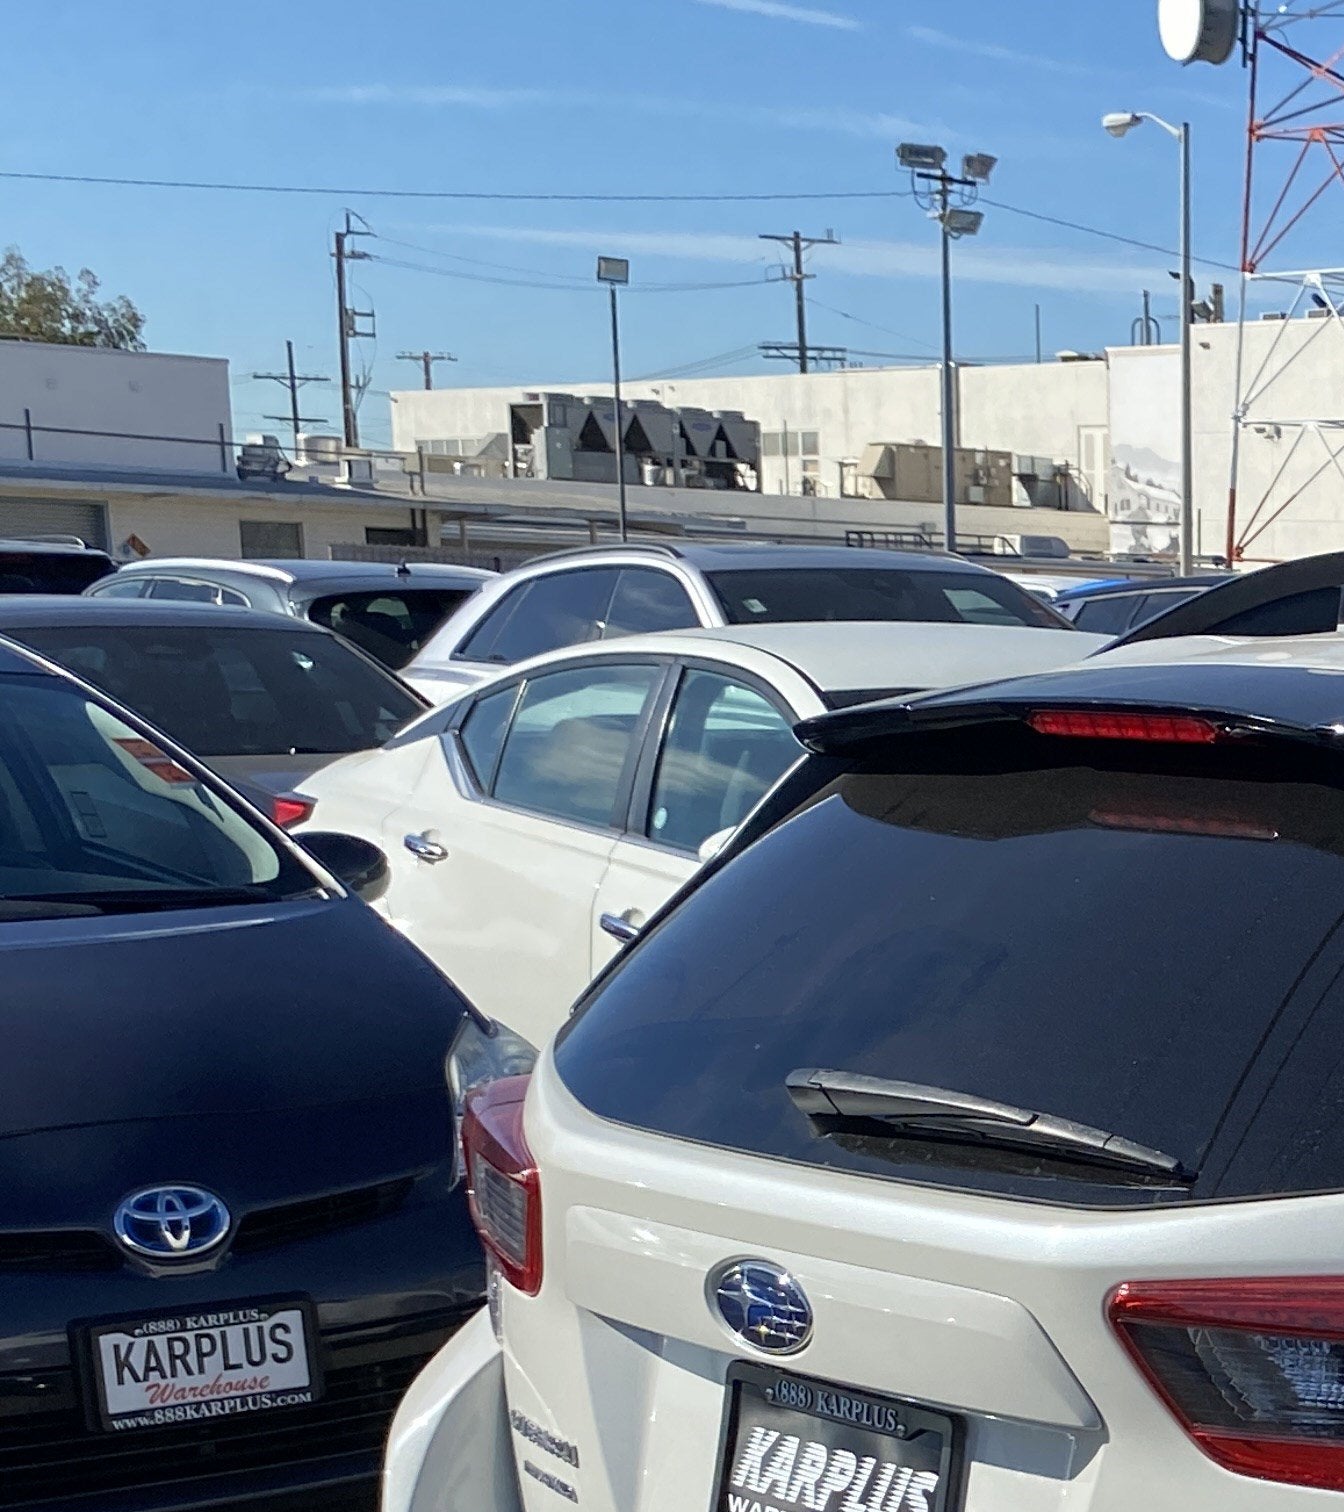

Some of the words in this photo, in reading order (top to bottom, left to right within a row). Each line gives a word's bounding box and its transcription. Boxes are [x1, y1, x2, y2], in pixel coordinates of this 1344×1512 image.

[142, 1319, 181, 1334] (888)
[186, 1309, 259, 1329] KARPLUS
[113, 1323, 294, 1386] KARPLUS
[145, 1372, 271, 1405] Warehouse
[774, 1379, 814, 1409] (888)
[816, 1389, 898, 1431] KARPLUS
